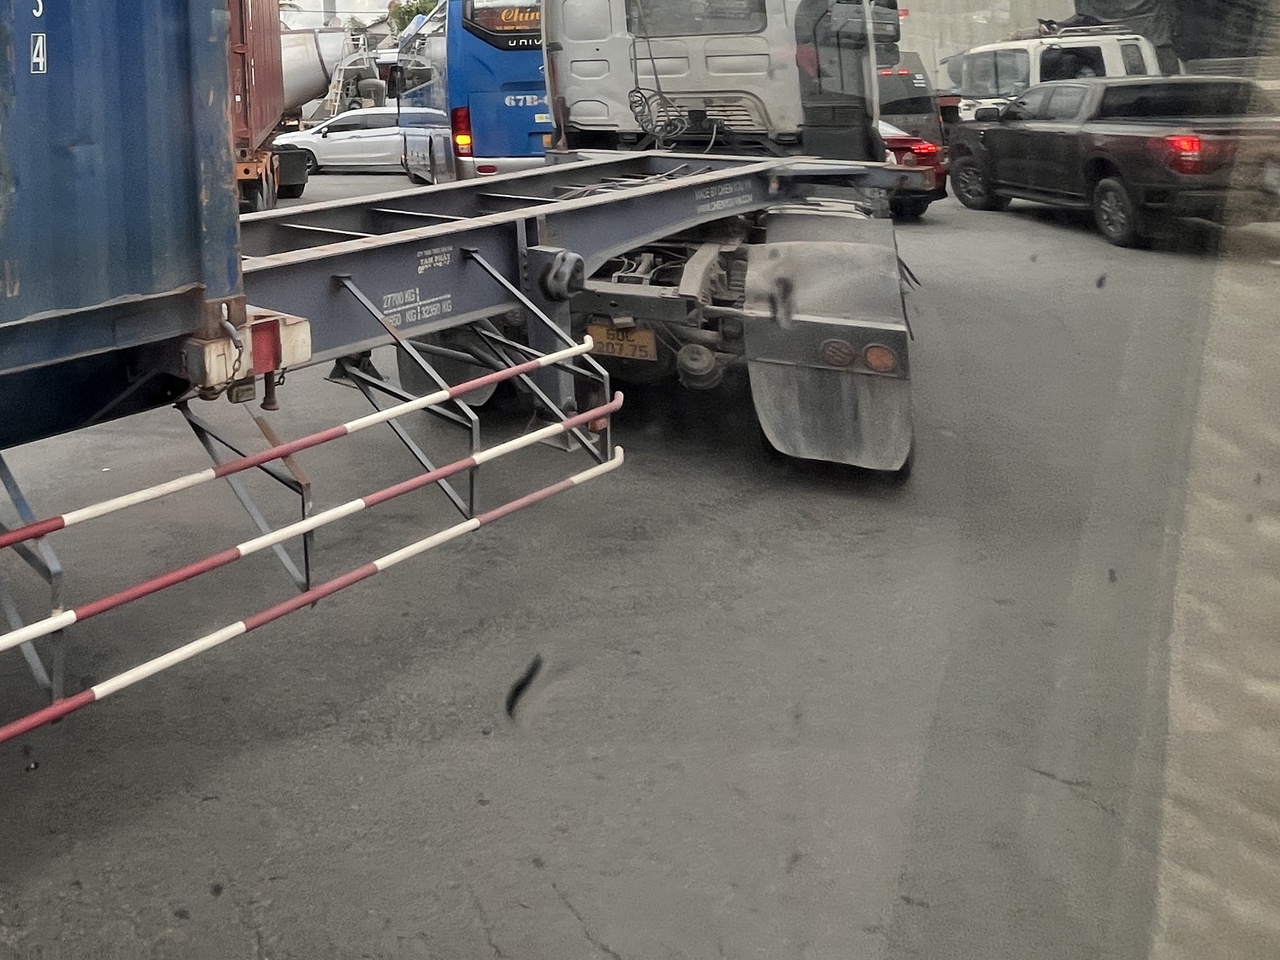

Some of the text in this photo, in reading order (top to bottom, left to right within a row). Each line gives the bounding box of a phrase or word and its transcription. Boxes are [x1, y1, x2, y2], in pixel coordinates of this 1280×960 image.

[31, 34, 46, 72] 4
[405, 289, 415, 302] KG
[442, 300, 452, 313] KG
[405, 309, 417, 323] KG
